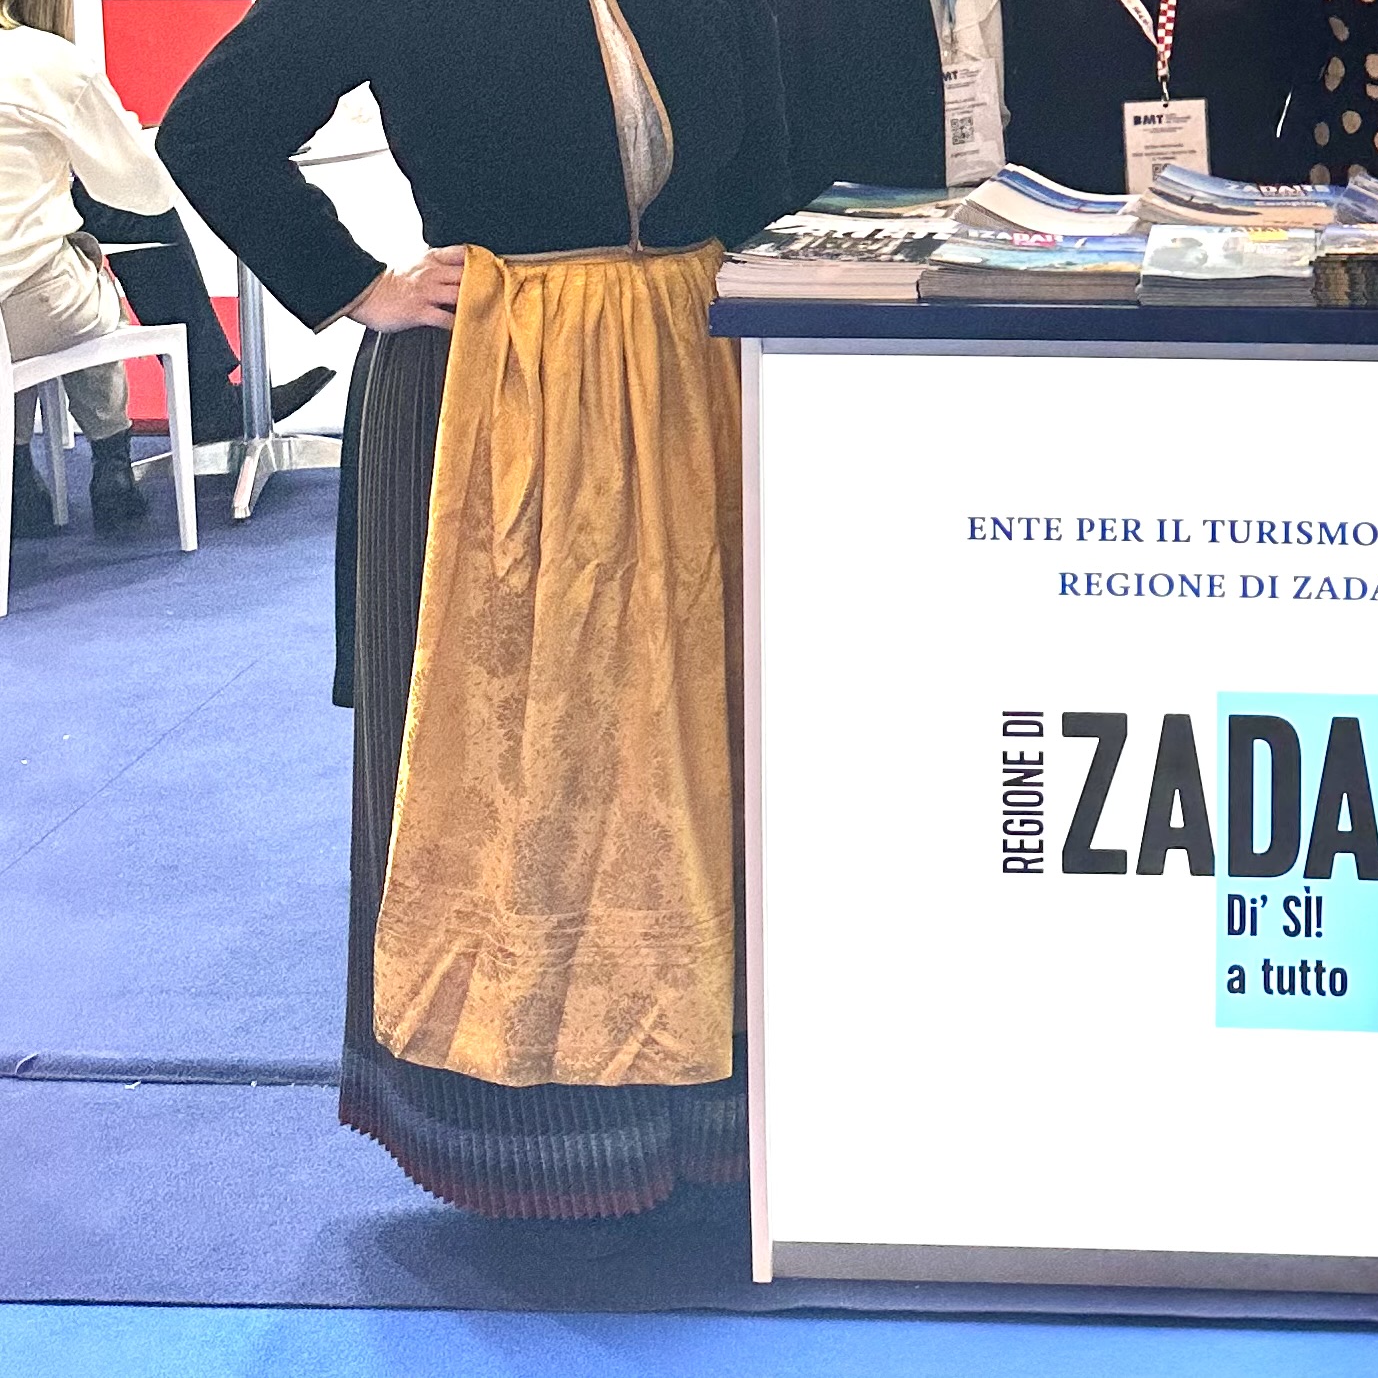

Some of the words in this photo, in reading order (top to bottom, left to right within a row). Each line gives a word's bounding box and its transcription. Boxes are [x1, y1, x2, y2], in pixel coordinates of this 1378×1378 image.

[1132, 113, 1164, 126] BMT
[966, 516, 1063, 542] ENTE
[1076, 517, 1145, 543] PER
[1156, 518, 1192, 543] IL
[1202, 519, 1378, 547] TURISMO
[1058, 572, 1226, 598] REGIONE
[1239, 574, 1279, 599] DI
[1003, 710, 1044, 739] DI
[1003, 751, 1044, 874] REGIONE
[1226, 963, 1247, 996] a
[1261, 957, 1349, 998] tutto
